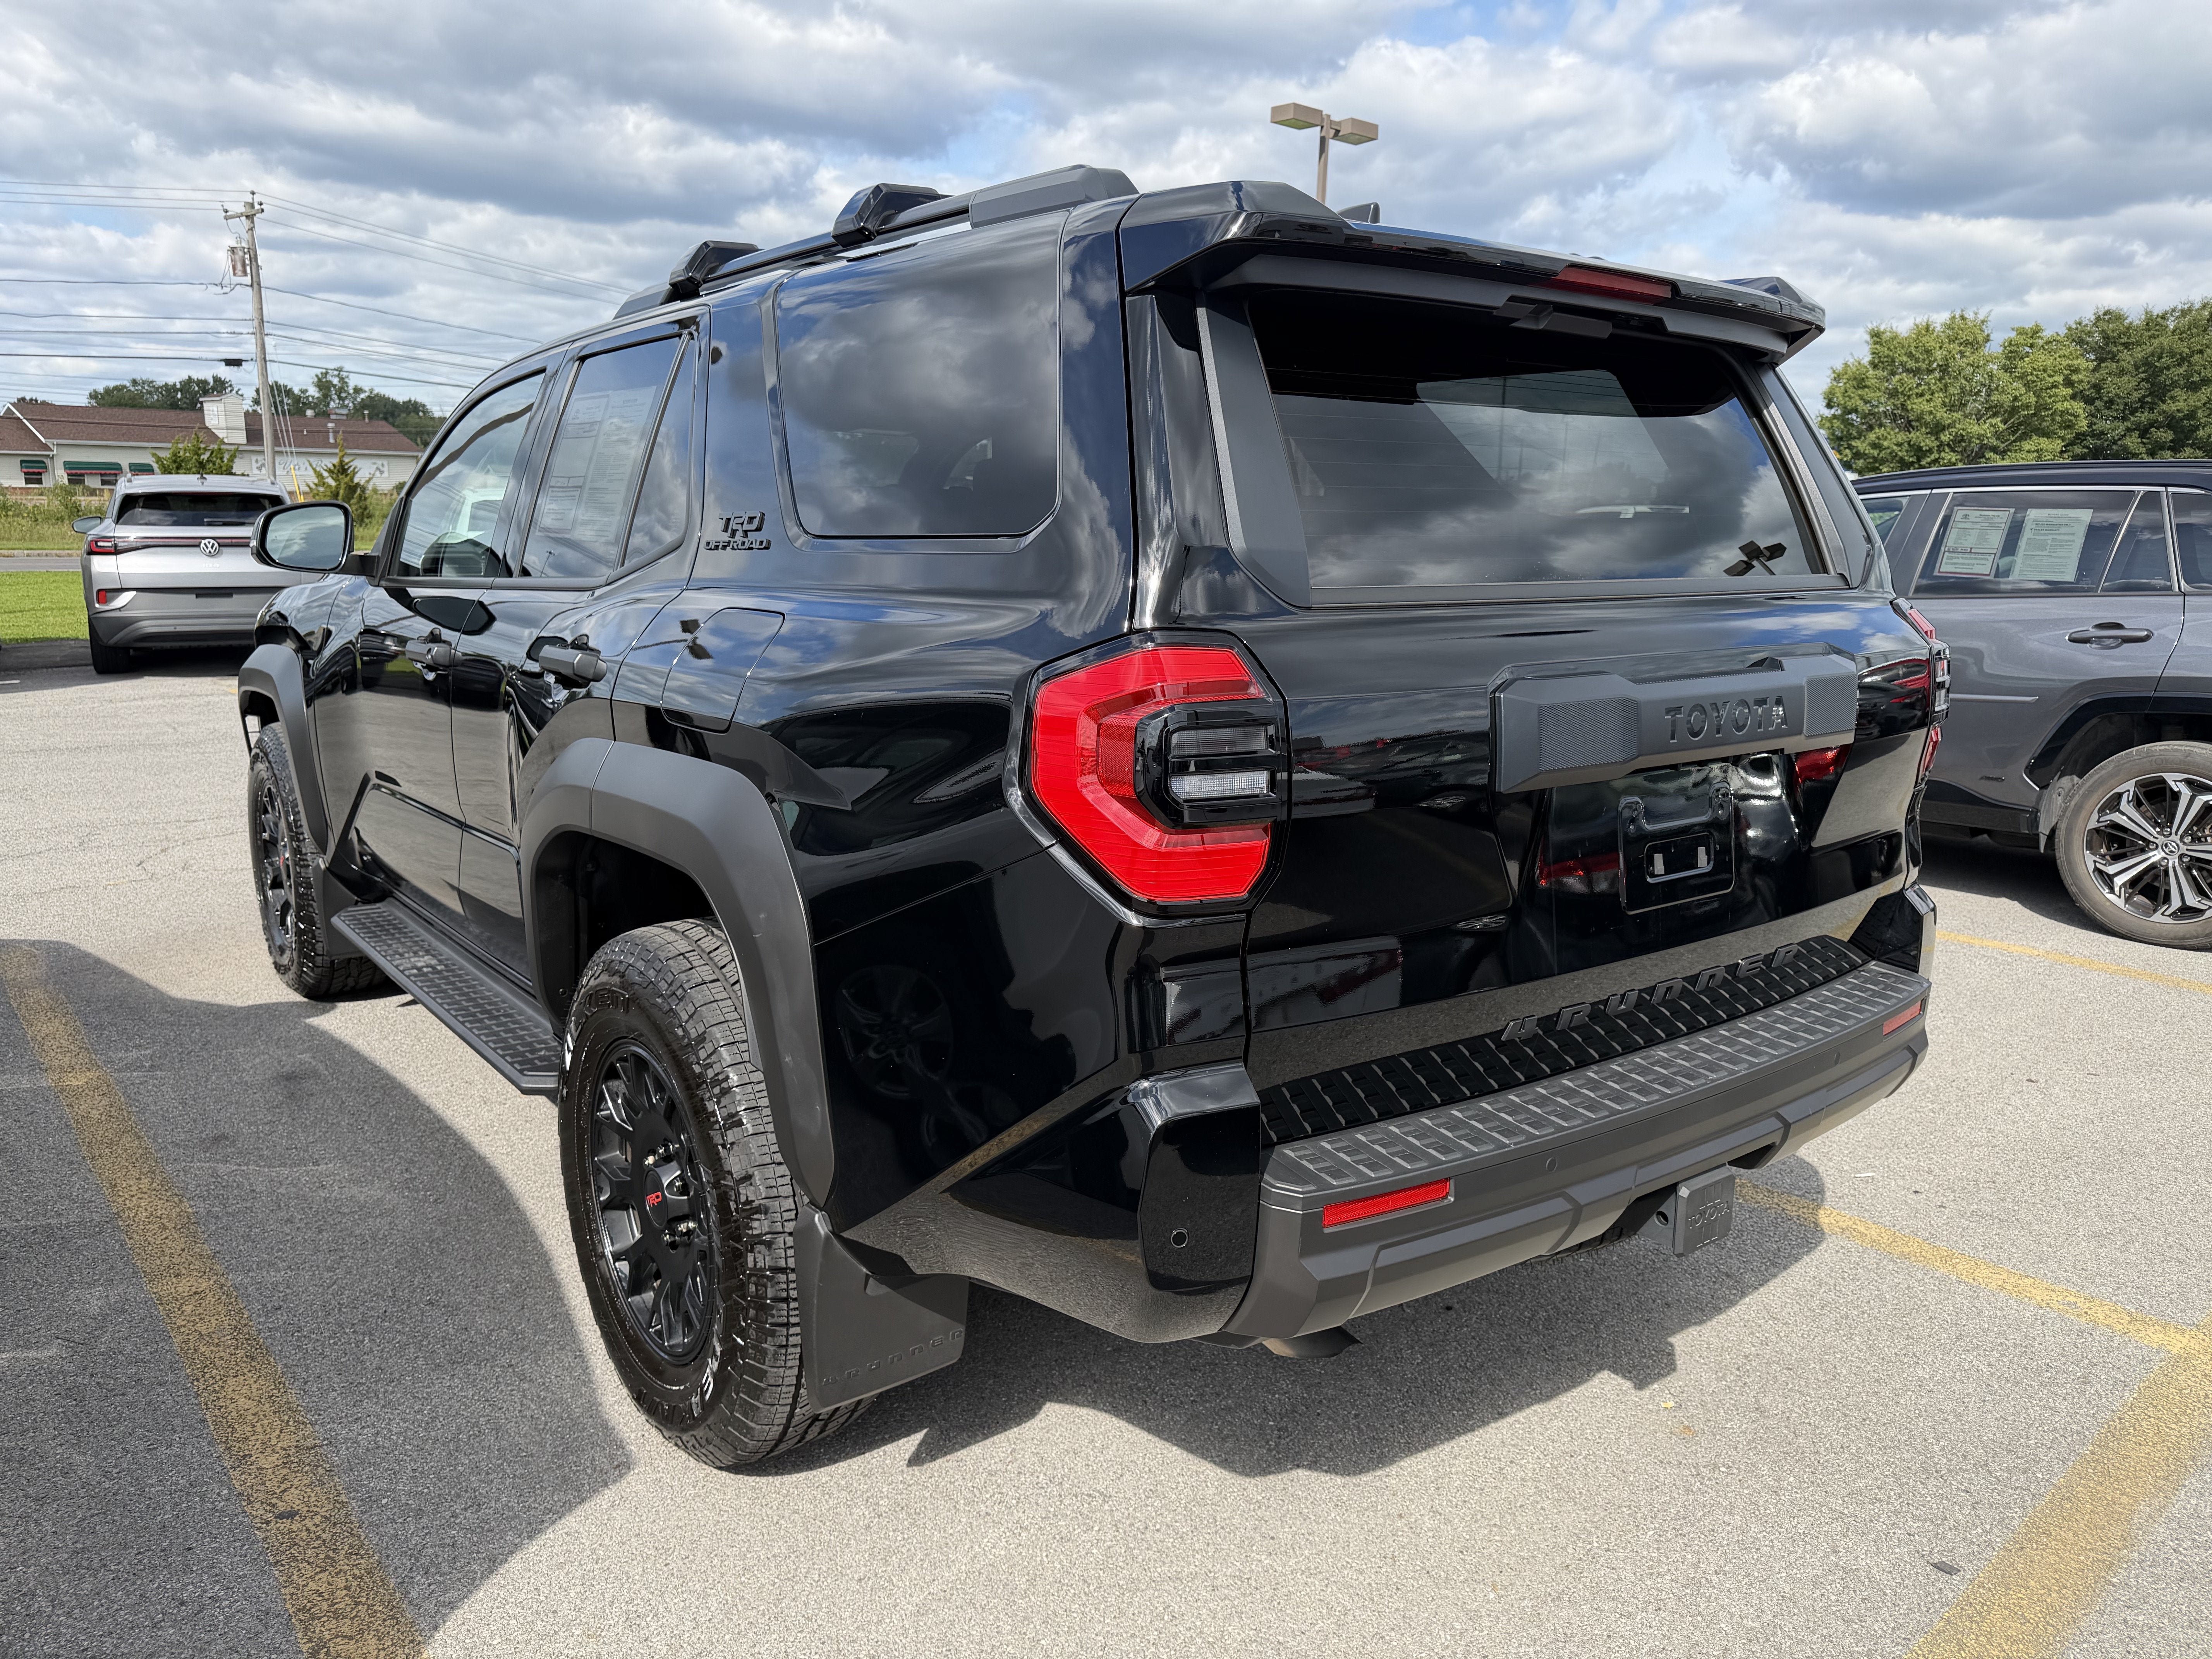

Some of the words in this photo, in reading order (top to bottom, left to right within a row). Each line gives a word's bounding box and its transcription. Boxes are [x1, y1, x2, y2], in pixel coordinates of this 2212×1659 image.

[719, 510, 766, 539] TRD
[1664, 696, 1788, 743] TOYOTA
[1501, 943, 1798, 1041] 4RUNNER
[646, 1192, 662, 1207] TRD
[1688, 1200, 1730, 1230] TOYOTA
[822, 1328, 964, 1386] 4RUNNER
